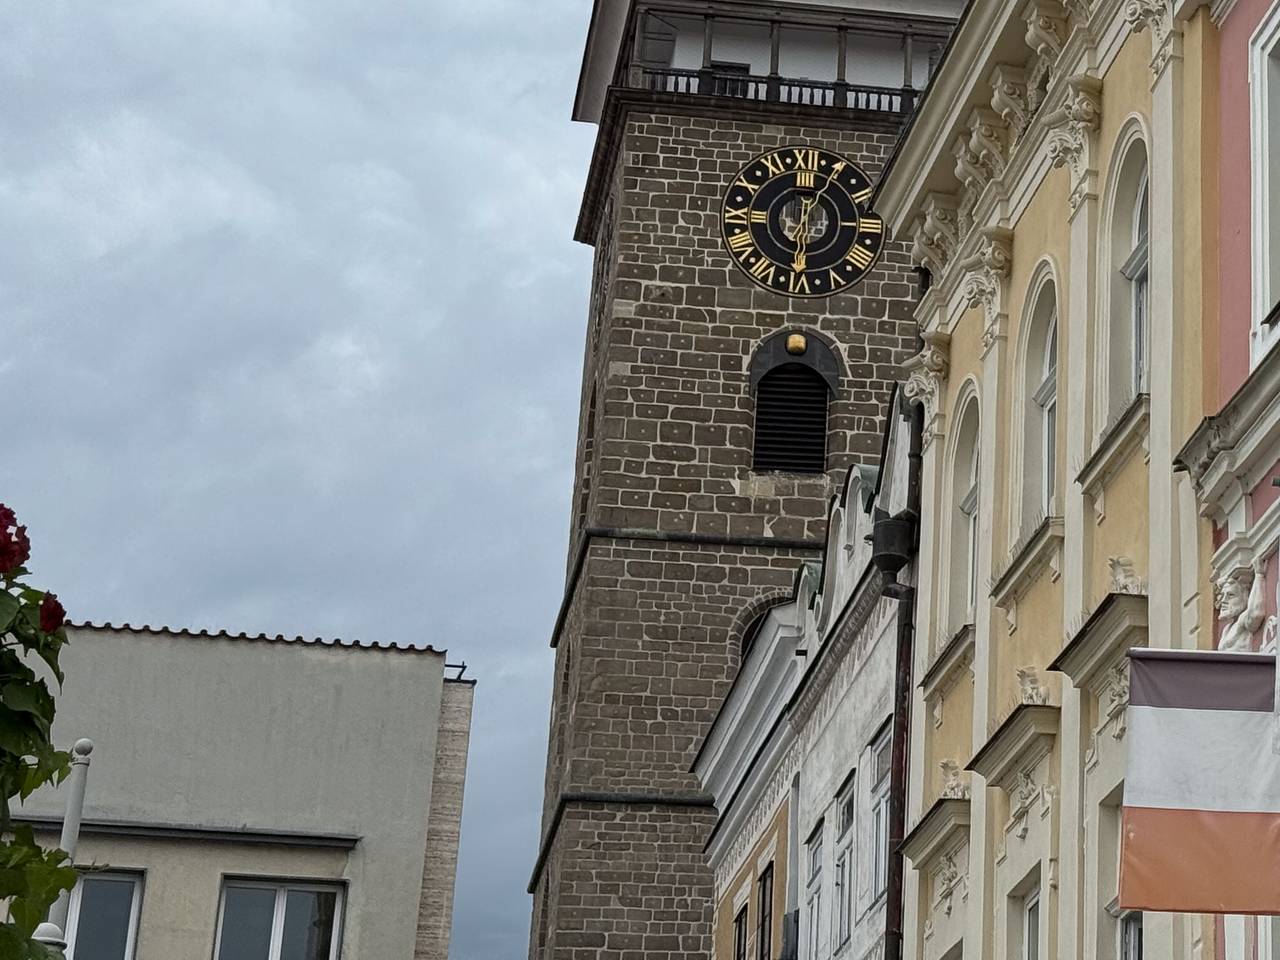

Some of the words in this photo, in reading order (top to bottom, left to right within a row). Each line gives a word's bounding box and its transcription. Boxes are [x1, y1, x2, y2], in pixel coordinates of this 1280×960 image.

[760, 153, 786, 178] XI
[793, 149, 819, 171] XII
[735, 175, 760, 195] X
[851, 186, 873, 204] II
[725, 206, 748, 225] IX
[859, 218, 882, 233] III
[728, 231, 755, 263] VIII
[846, 244, 874, 271] IIII
[749, 257, 776, 286] VII
[788, 271, 811, 294] VI
[829, 268, 847, 289] V
